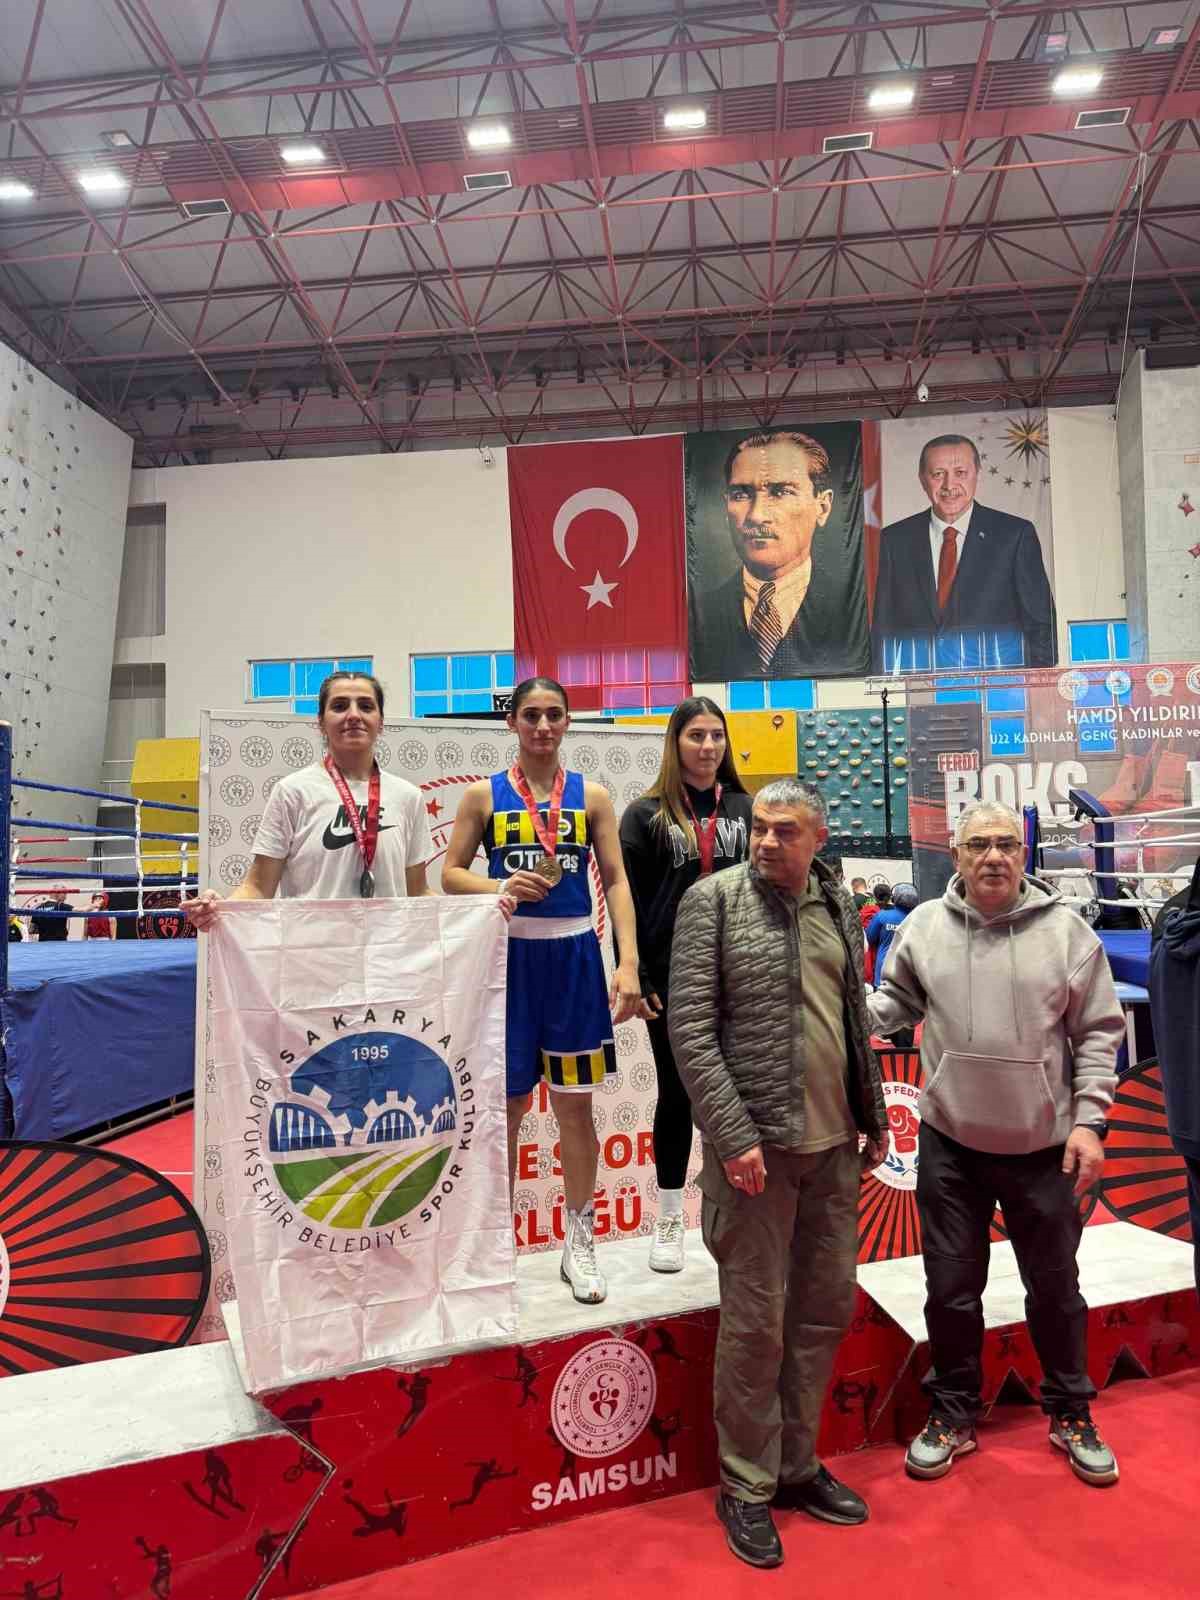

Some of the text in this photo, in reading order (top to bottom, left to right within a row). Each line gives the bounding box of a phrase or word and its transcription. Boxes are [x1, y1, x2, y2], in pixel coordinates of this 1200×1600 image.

[1066, 704, 1124, 725] HAMDİ
[990, 733, 1009, 745] U22
[1122, 727, 1183, 740] KADINLAR
[280, 1008, 452, 1064] SAKARYA
[351, 1045, 389, 1061] 1995
[243, 1056, 475, 1253] BÜYÜKŞEHİR BELEDİYE SPOR KULÜBÜ
[531, 1451, 678, 1512] SAMSUN
